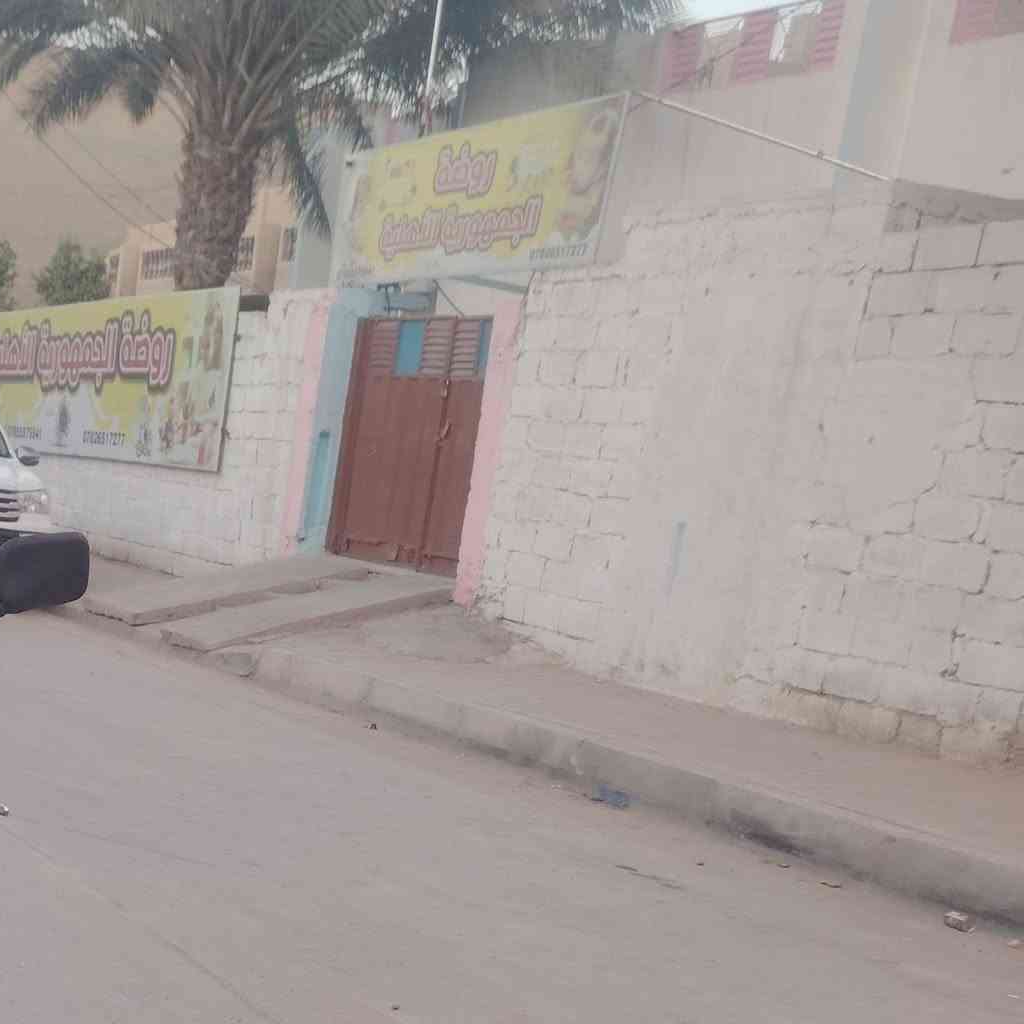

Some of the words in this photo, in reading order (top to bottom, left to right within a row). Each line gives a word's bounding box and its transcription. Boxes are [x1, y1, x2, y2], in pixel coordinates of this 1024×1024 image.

[434, 142, 497, 197] روضة
[37, 319, 120, 393] الجمهورية
[119, 309, 174, 392] روضة
